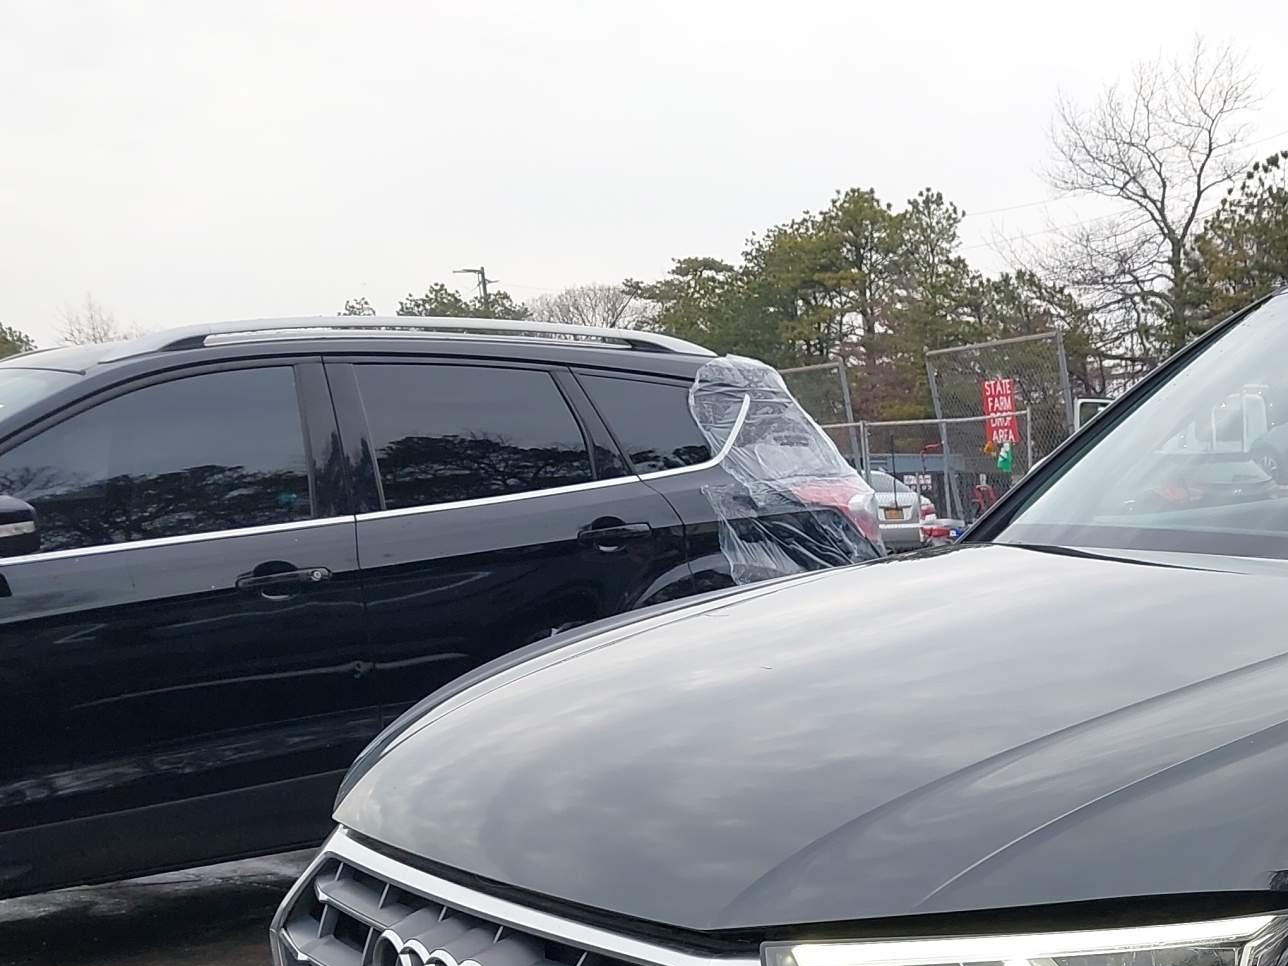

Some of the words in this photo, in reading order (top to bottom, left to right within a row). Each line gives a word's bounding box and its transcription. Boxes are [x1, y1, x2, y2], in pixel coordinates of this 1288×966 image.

[984, 379, 1012, 396] STATE
[987, 395, 1013, 412] FARM
[992, 428, 1017, 443] AREA
